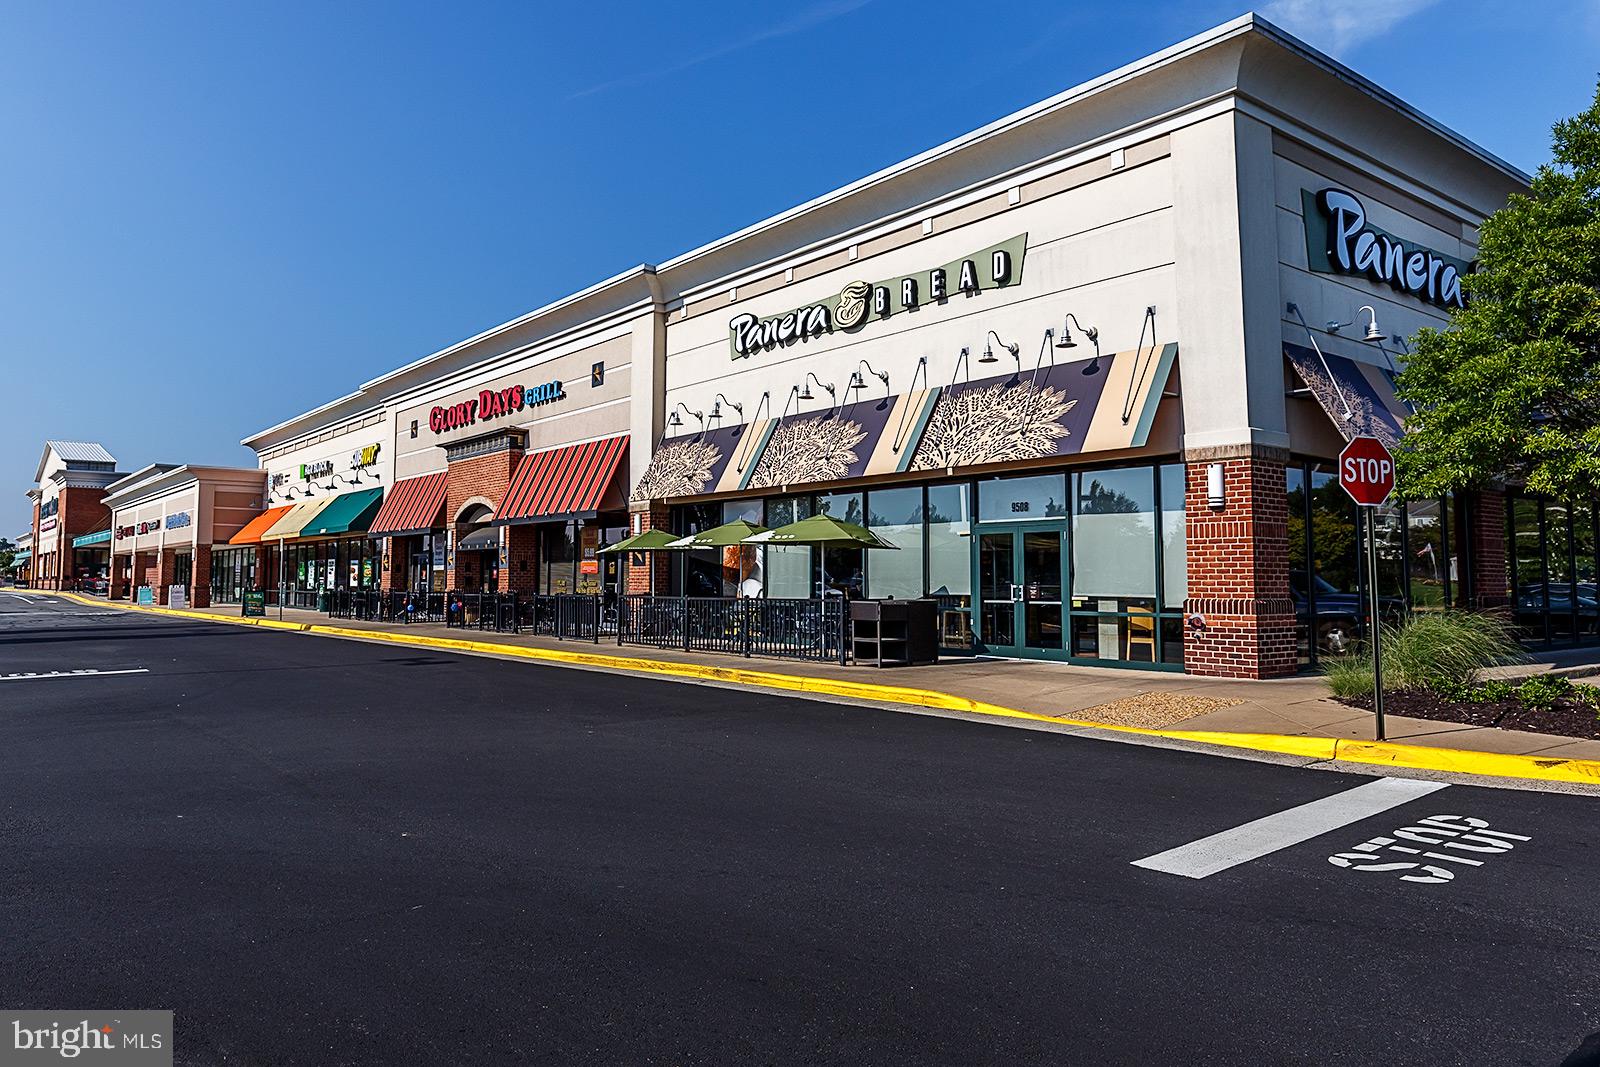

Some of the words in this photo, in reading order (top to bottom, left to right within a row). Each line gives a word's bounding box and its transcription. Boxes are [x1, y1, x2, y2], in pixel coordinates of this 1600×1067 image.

[1325, 190, 1464, 308] Panera
[730, 304, 828, 352] Panera
[875, 250, 1008, 314] BREAD
[429, 399, 477, 433] GLORY
[478, 384, 523, 420] DAYS
[524, 380, 562, 406] GRILL
[1344, 457, 1392, 485] STOP
[1011, 501, 1029, 513] 9508
[1328, 814, 1531, 884] STOP
